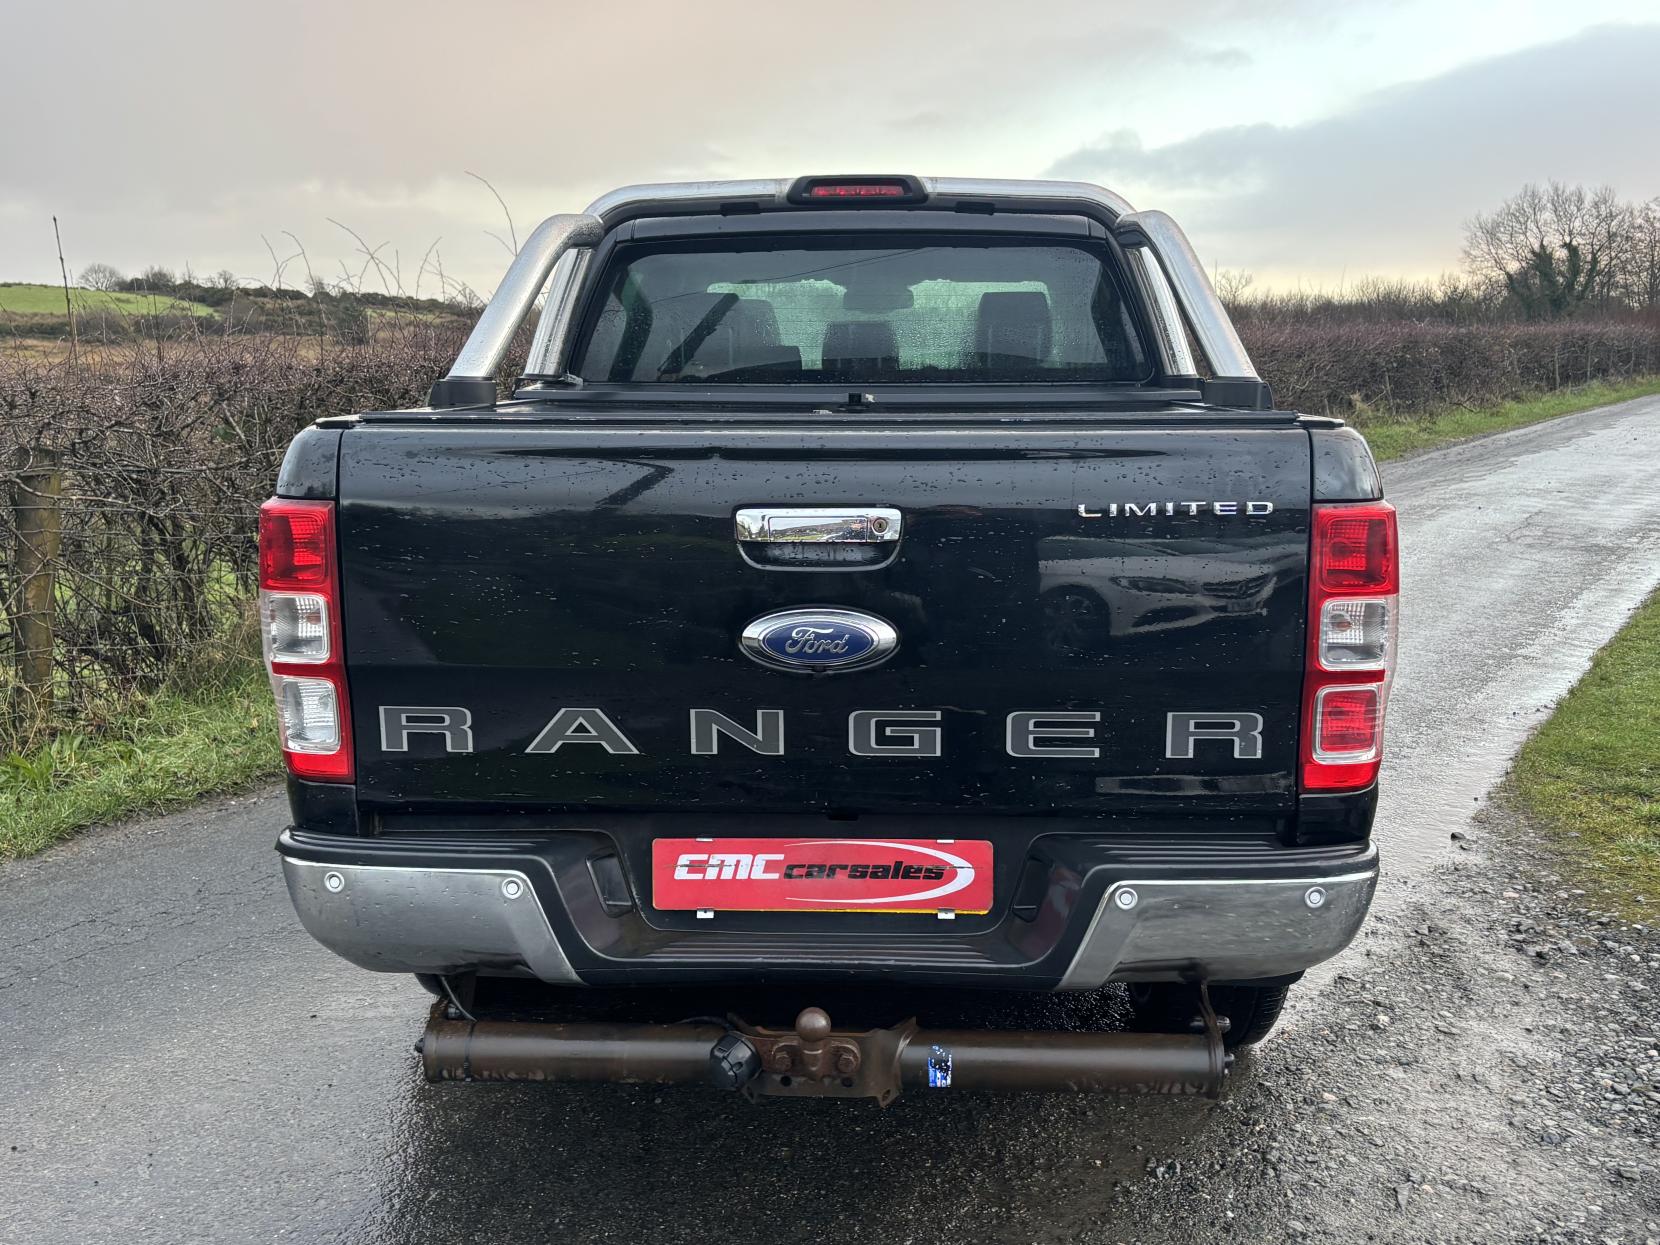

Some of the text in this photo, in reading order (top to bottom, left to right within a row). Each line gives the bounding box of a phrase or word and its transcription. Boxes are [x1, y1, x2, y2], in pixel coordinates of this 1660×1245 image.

[1077, 501, 1274, 518] LIMITED
[784, 626, 851, 654] Ford
[378, 705, 1264, 760] RANGER
[673, 853, 945, 881] CMC carsales
